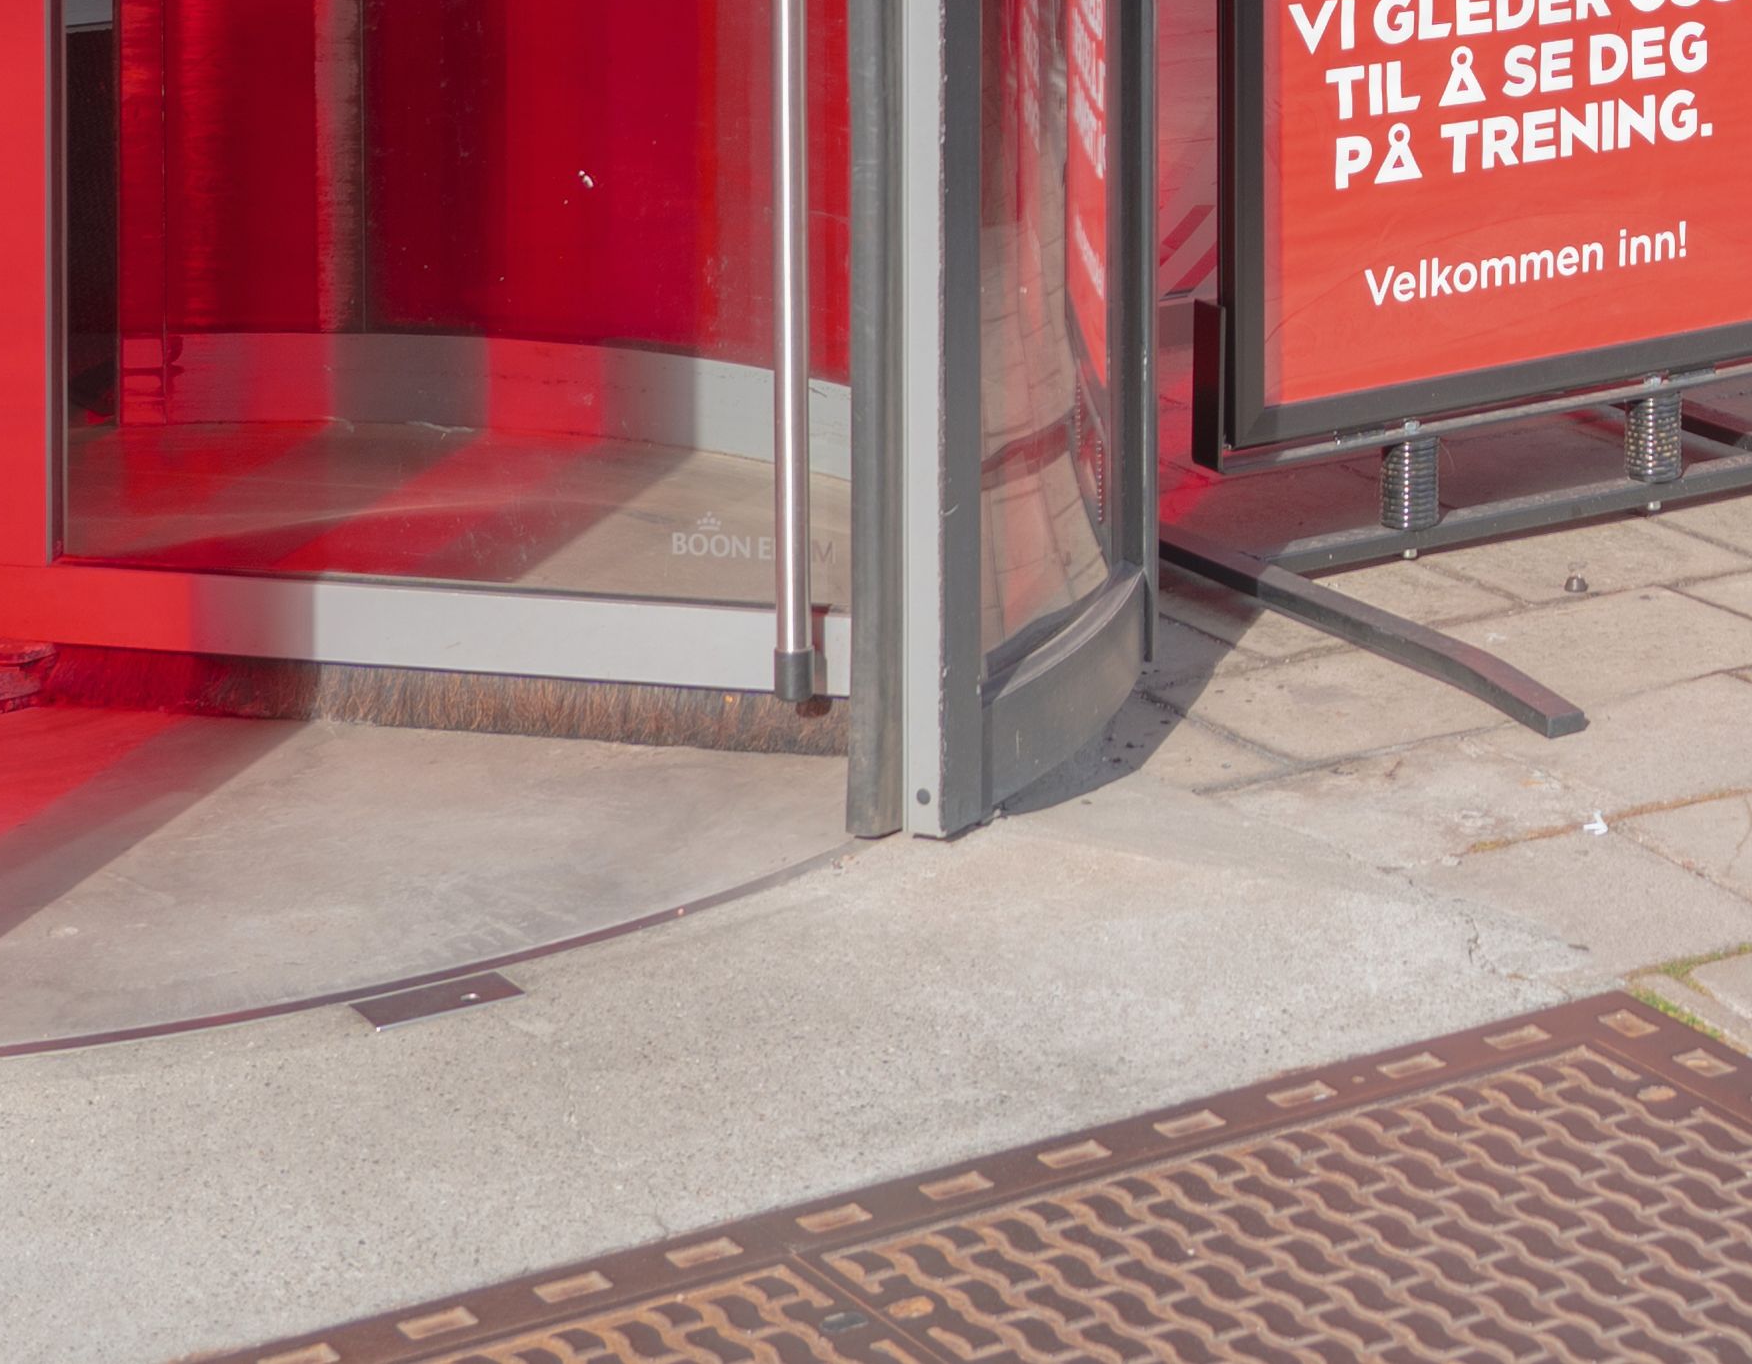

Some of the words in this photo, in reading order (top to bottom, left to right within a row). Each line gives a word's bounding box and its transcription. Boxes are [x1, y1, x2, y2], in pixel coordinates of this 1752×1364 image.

[1325, 60, 1421, 121] TIL
[1438, 45, 1487, 107] Å
[1502, 38, 1574, 98] SE
[1589, 21, 1709, 86] DEG
[1334, 122, 1423, 190] PÅ
[1440, 89, 1714, 174] TRENING.
[1364, 239, 1605, 307] Velkommen
[1617, 220, 1688, 269] inn!
[671, 530, 750, 559] BOON
